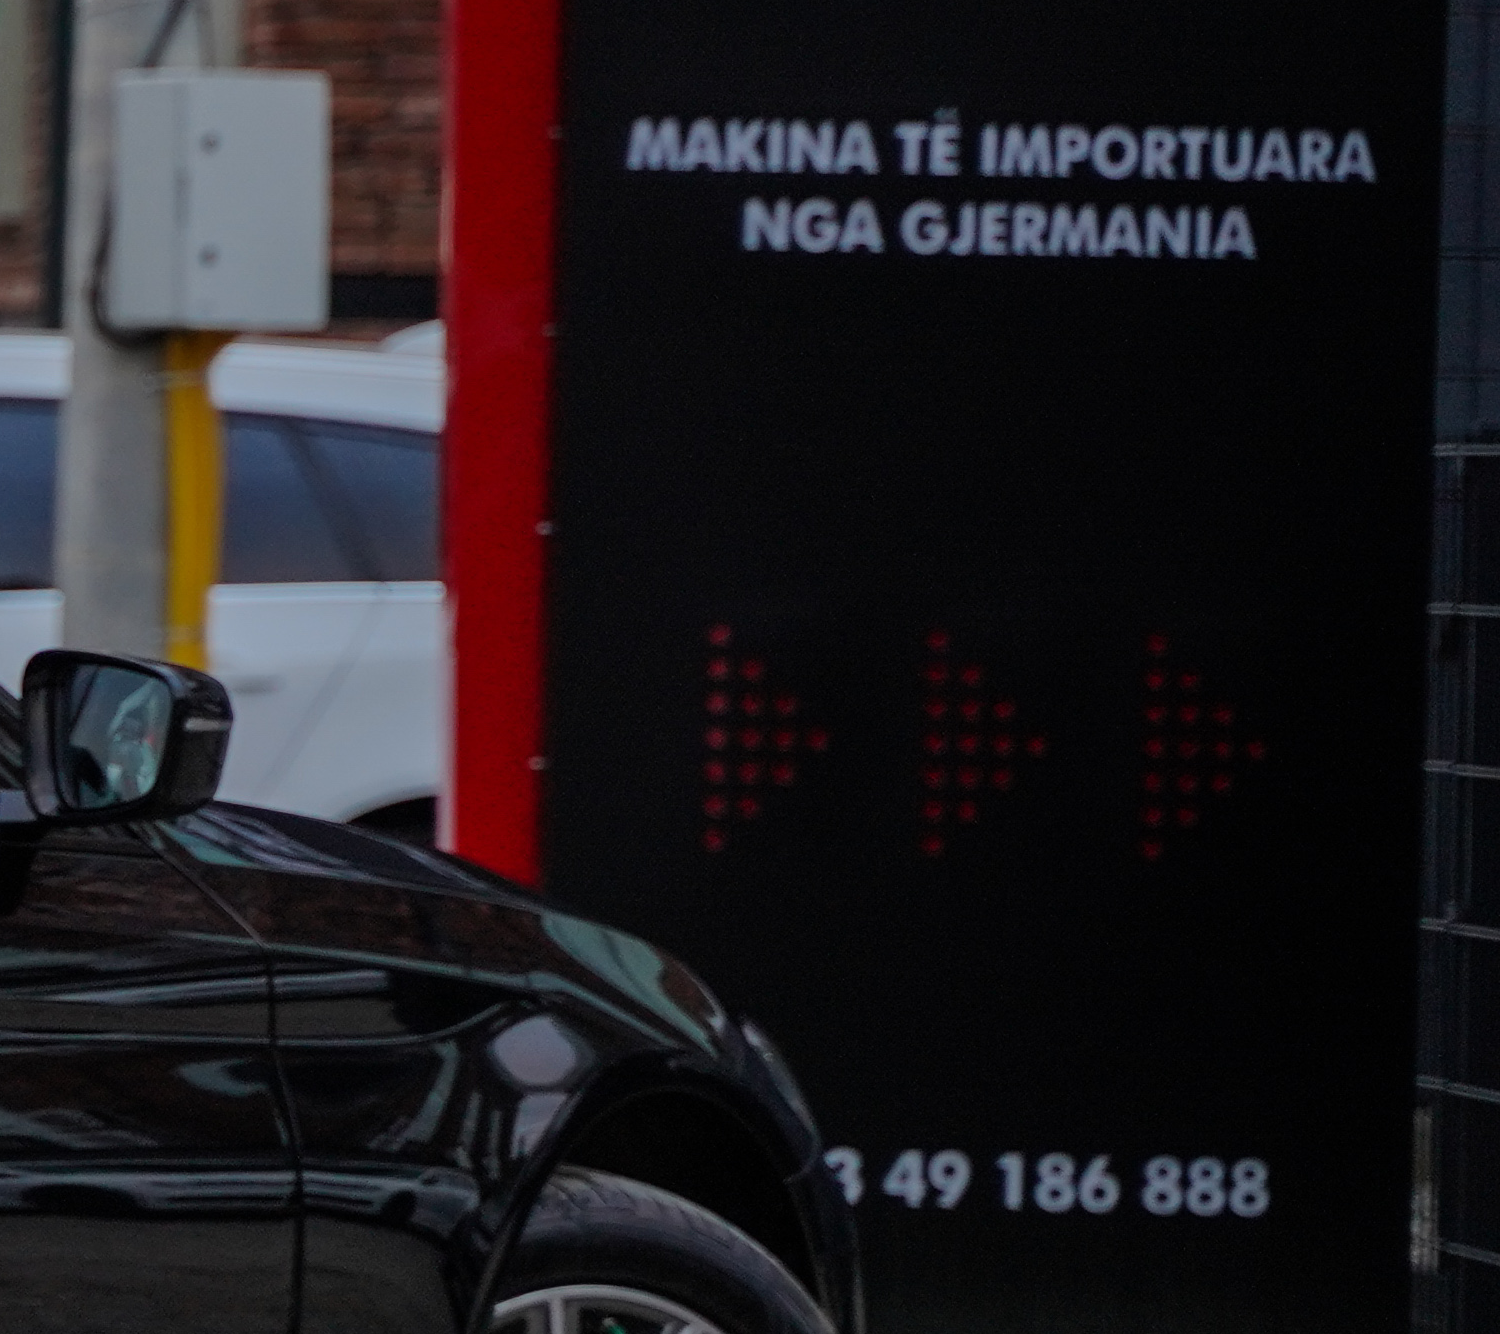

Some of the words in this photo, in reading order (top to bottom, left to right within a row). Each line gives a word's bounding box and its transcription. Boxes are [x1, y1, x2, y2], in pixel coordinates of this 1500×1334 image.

[625, 116, 880, 174] MAKINA
[978, 122, 1376, 183] IMPORTUARA
[741, 197, 885, 255] NGA
[898, 200, 1257, 260] GJERMANIA
[881, 1148, 974, 1210] 49
[996, 1151, 1121, 1215] 186
[1140, 1154, 1271, 1218] 888
